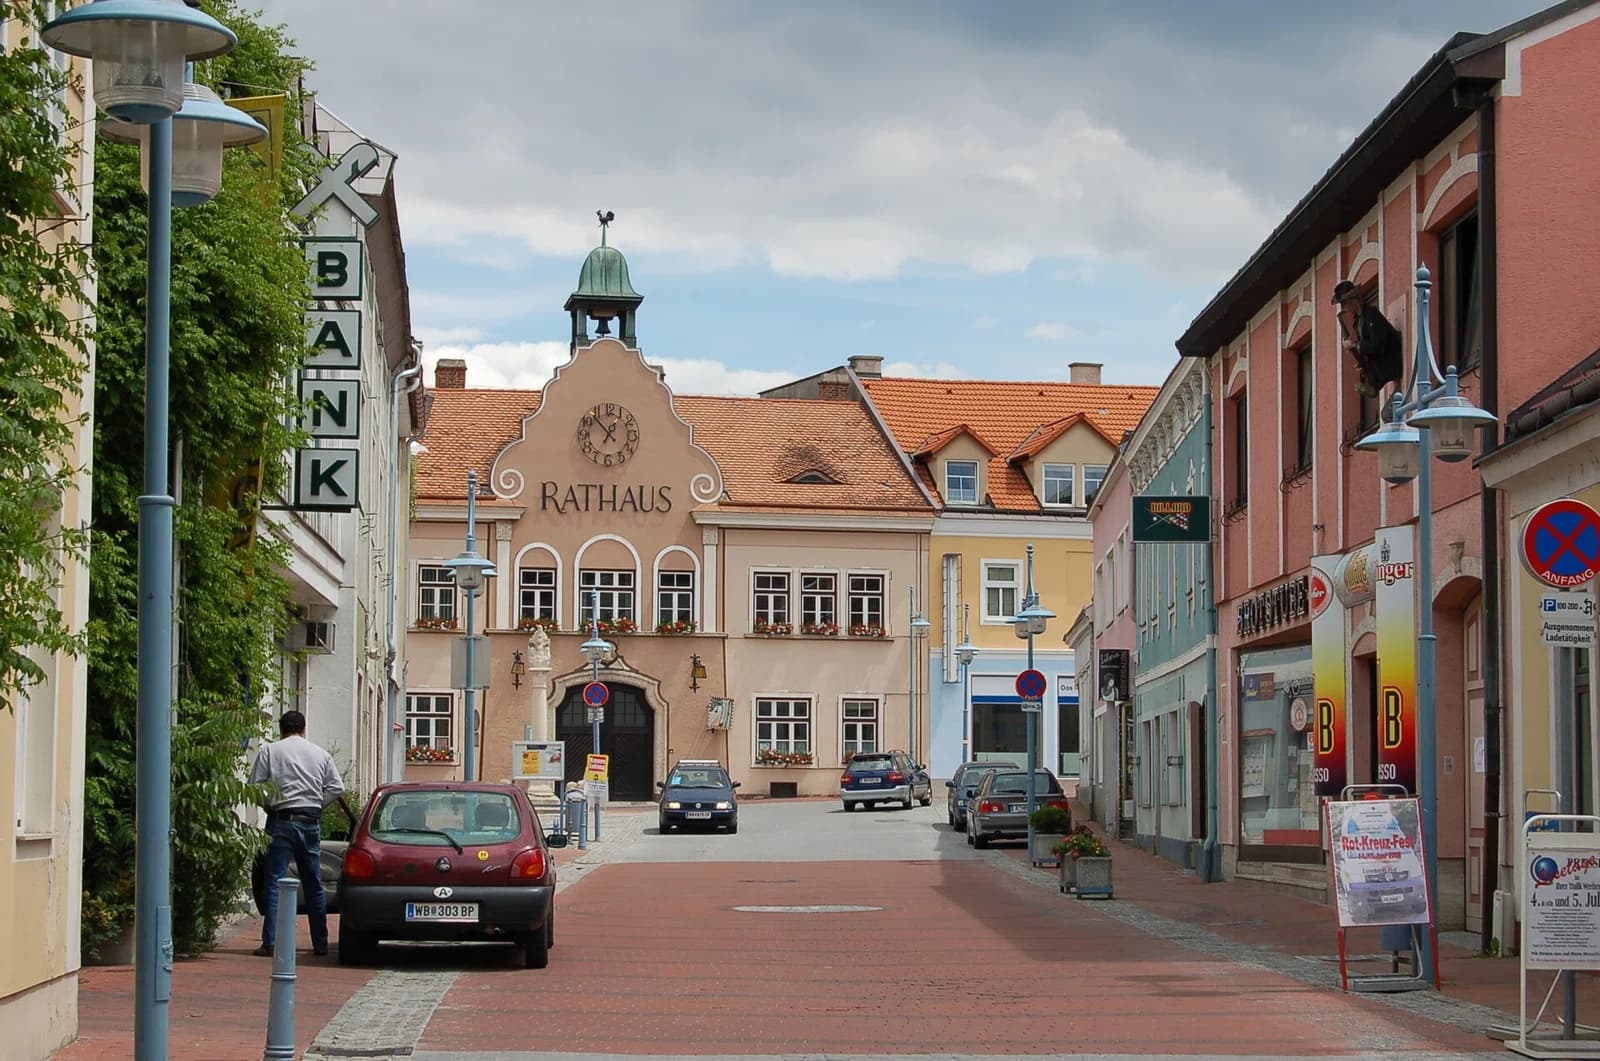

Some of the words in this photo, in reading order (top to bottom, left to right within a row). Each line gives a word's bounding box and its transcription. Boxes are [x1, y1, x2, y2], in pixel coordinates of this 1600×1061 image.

[309, 250, 353, 498] BANK
[541, 481, 672, 514] RATHAUS
[1541, 568, 1595, 586] ANFANG
[1236, 575, 1308, 637] BROTSTUBE
[1543, 621, 1595, 633] Ausgenommen
[1545, 633, 1591, 644] Ladetätigkeit
[1061, 684, 1073, 692] Das
[1383, 687, 1402, 749] B
[1318, 699, 1335, 755] B
[438, 888, 448, 897] A
[1555, 896, 1569, 907] und
[1572, 893, 1582, 907] 5.
[415, 905, 430, 917] WB
[438, 905, 458, 917] 303
[461, 906, 474, 917] BP
